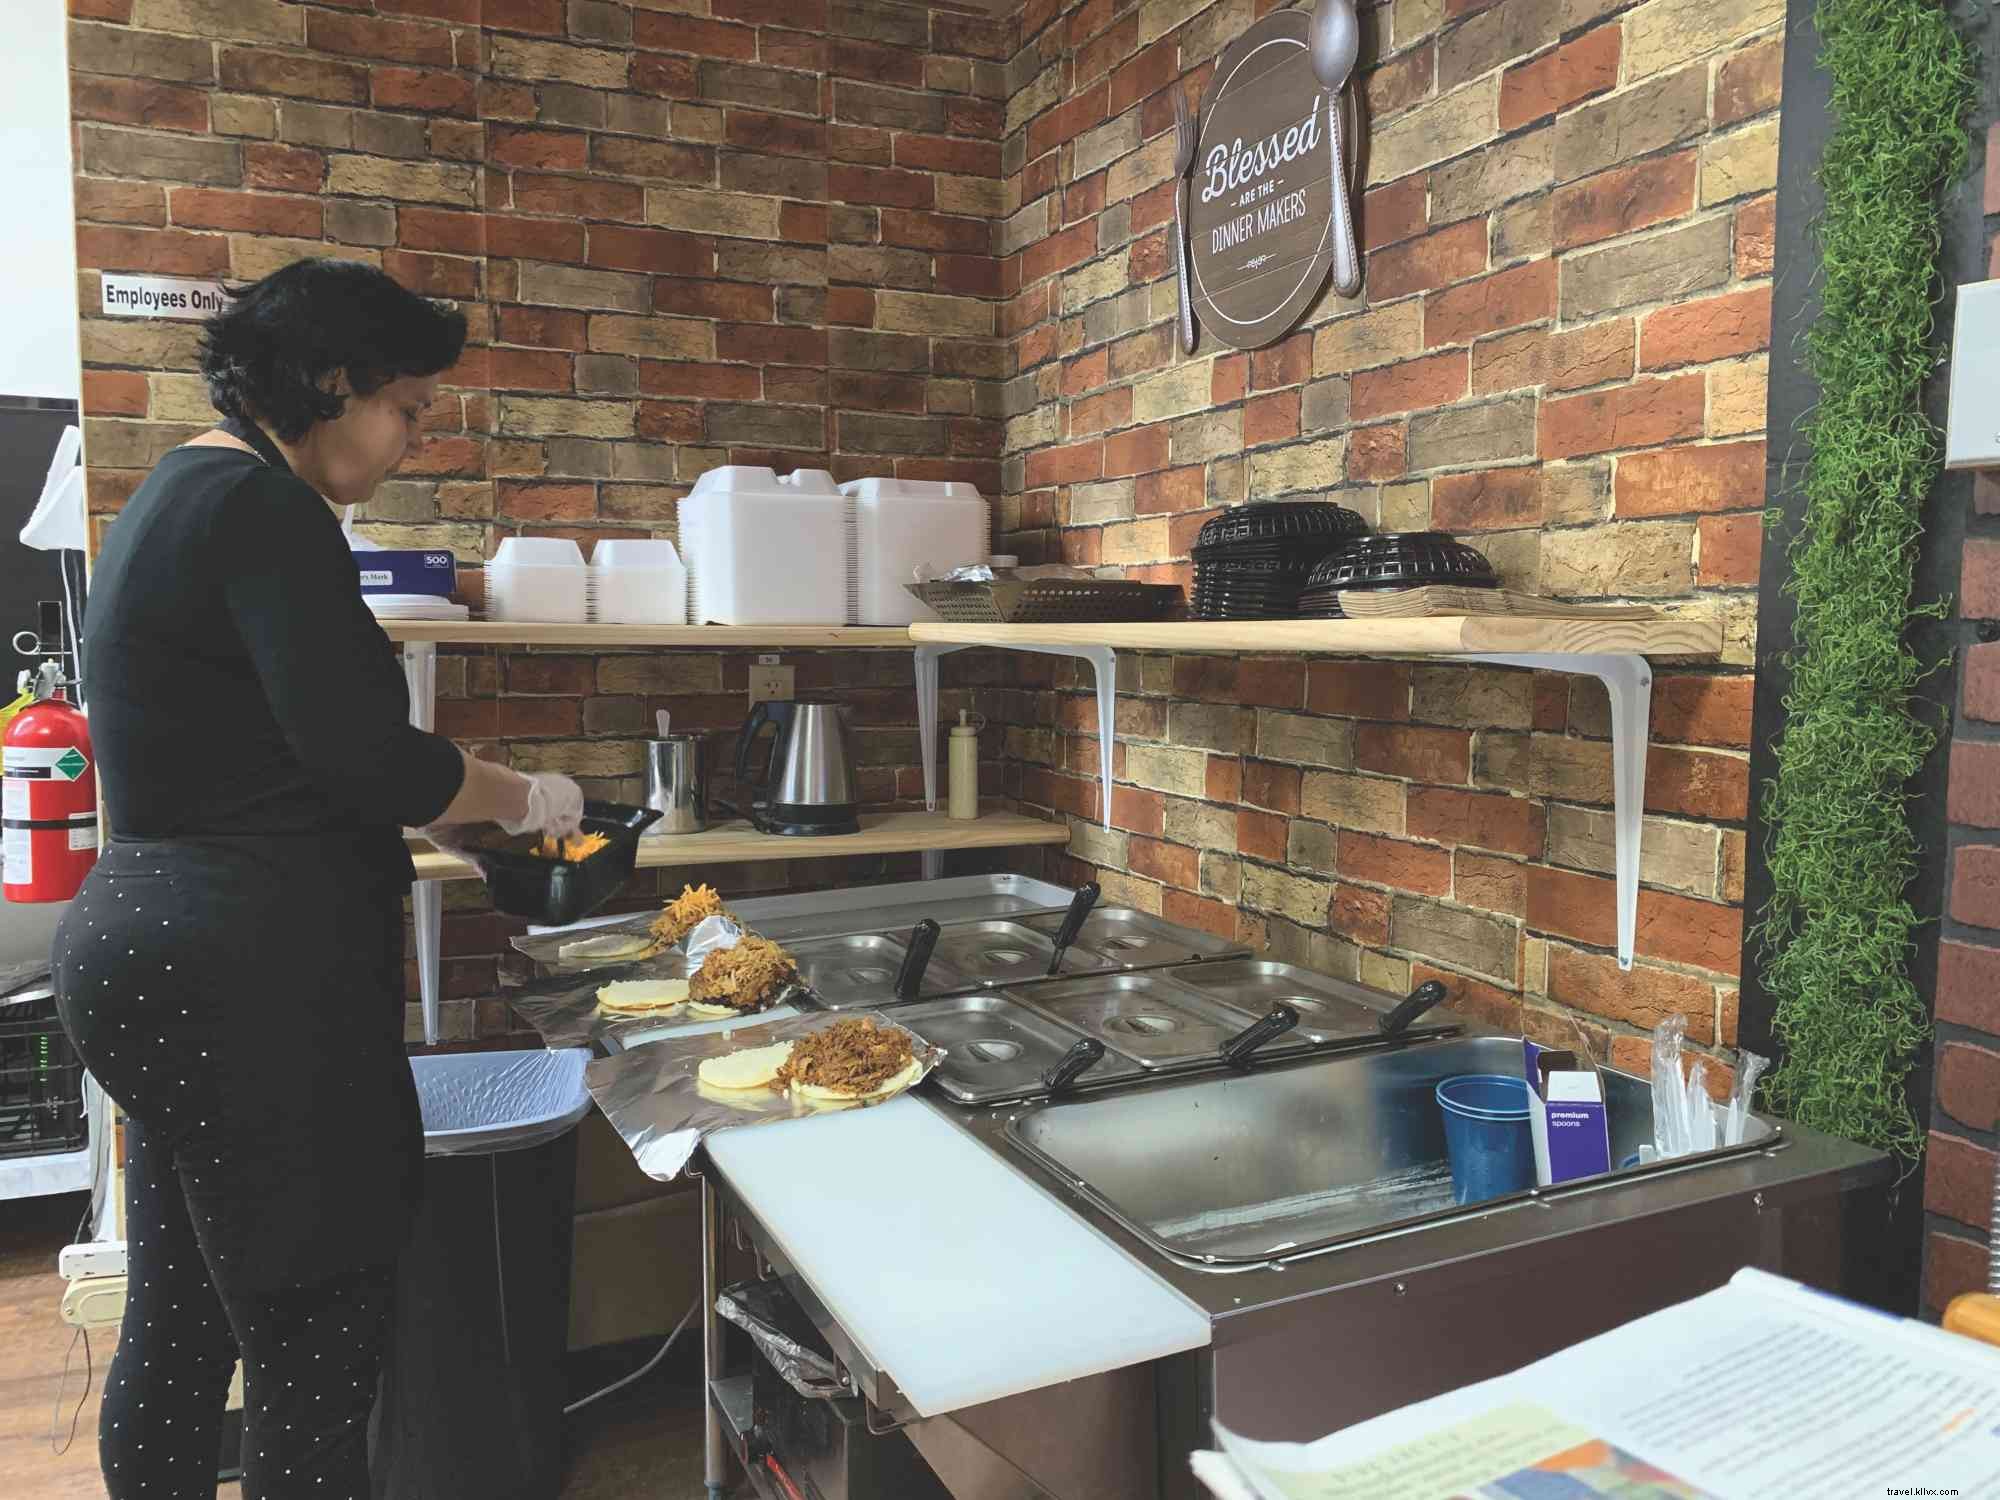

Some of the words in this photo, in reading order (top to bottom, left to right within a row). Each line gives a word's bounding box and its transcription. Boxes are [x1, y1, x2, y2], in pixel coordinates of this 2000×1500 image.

[1202, 95, 1321, 203] Blessed
[1239, 191, 1256, 207] ARE
[1257, 184, 1275, 200] THE
[1212, 214, 1254, 254] DINNER
[1257, 189, 1307, 235] MAKERS
[106, 284, 187, 311] Employees
[191, 289, 223, 313] Only
[426, 556, 448, 564] 500
[1551, 1111, 1589, 1120] premium
[1551, 1120, 1581, 1128] spoons
